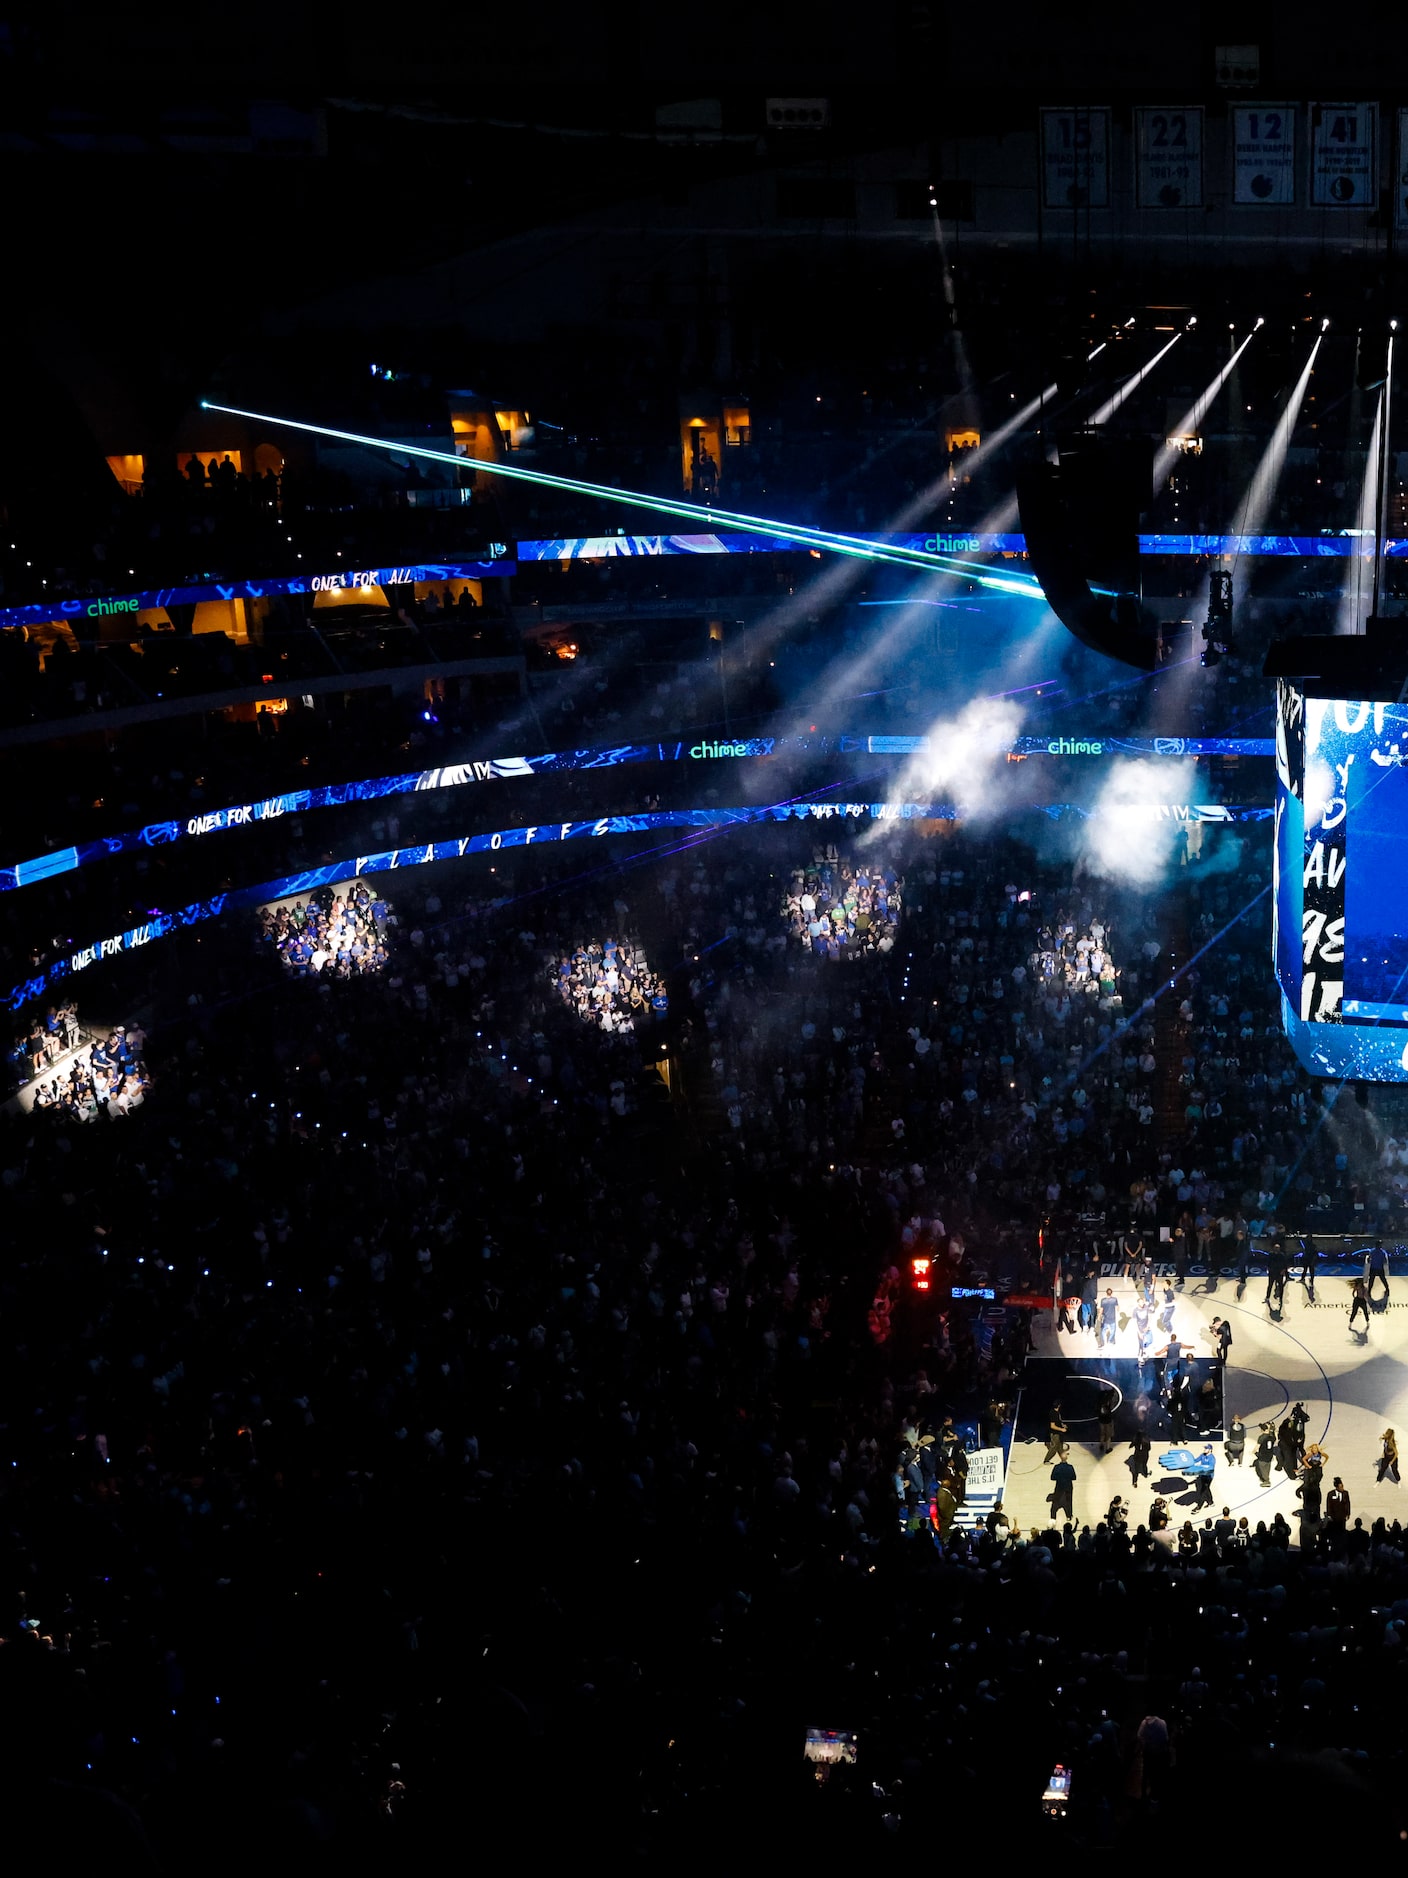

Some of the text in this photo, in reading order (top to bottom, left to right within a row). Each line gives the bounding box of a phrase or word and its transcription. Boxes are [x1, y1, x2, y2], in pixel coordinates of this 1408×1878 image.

[1058, 117, 1091, 148] 15
[1152, 115, 1187, 146] 22
[1249, 113, 1282, 139] 12
[1330, 117, 1357, 142] 41
[925, 533, 980, 552] chime
[311, 568, 413, 592] ONE FOR ALL
[88, 597, 139, 618] chime
[690, 740, 747, 760] chime
[1048, 737, 1103, 755] chime
[187, 798, 285, 835] ONE FOR ALL
[876, 806, 899, 819] ALL
[355, 818, 609, 876] PLAYOFFS
[72, 925, 151, 971] ONE FOR ALL
[985, 1455, 999, 1465] GET
[967, 1476, 980, 1486] THE
